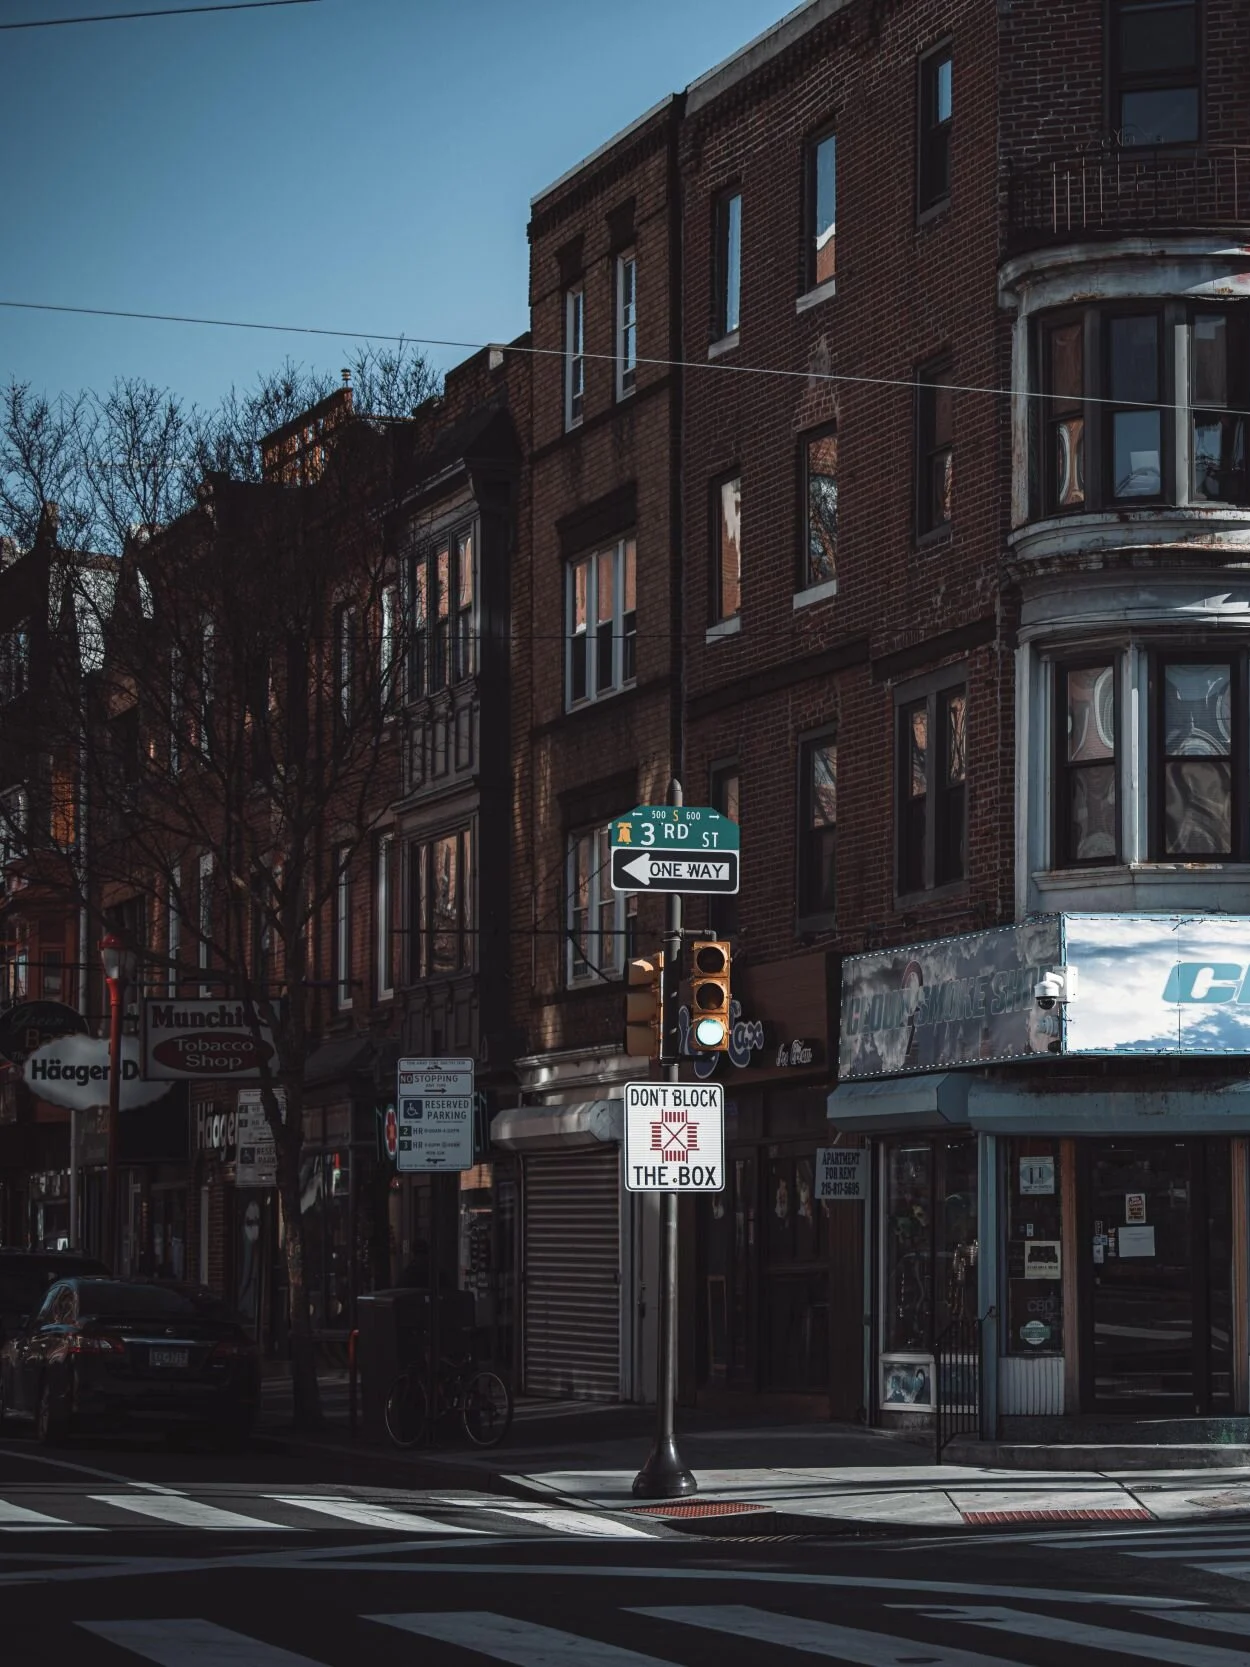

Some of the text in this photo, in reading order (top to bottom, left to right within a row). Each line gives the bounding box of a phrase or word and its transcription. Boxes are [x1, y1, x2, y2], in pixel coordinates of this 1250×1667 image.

[651, 809, 701, 822] 500 S 600
[702, 831, 719, 848] ST
[650, 862, 724, 879] ONE WAY
[916, 975, 989, 1028] SMOKE
[152, 1005, 257, 1029] Munchi
[171, 1038, 254, 1052] Tobacco
[186, 1054, 243, 1070] Shop
[400, 1075, 459, 1084] NO STOPPING
[630, 1087, 718, 1107] DON'T BLOCK
[425, 1100, 469, 1109] RESERVED
[427, 1111, 467, 1120] PARKING
[402, 1127, 409, 1135] 2
[412, 1127, 423, 1135] HR
[412, 1141, 423, 1149] HR
[822, 1151, 860, 1165] APARTMENT
[633, 1165, 716, 1186] THE BOX
[825, 1166, 857, 1180] FOR RENT
